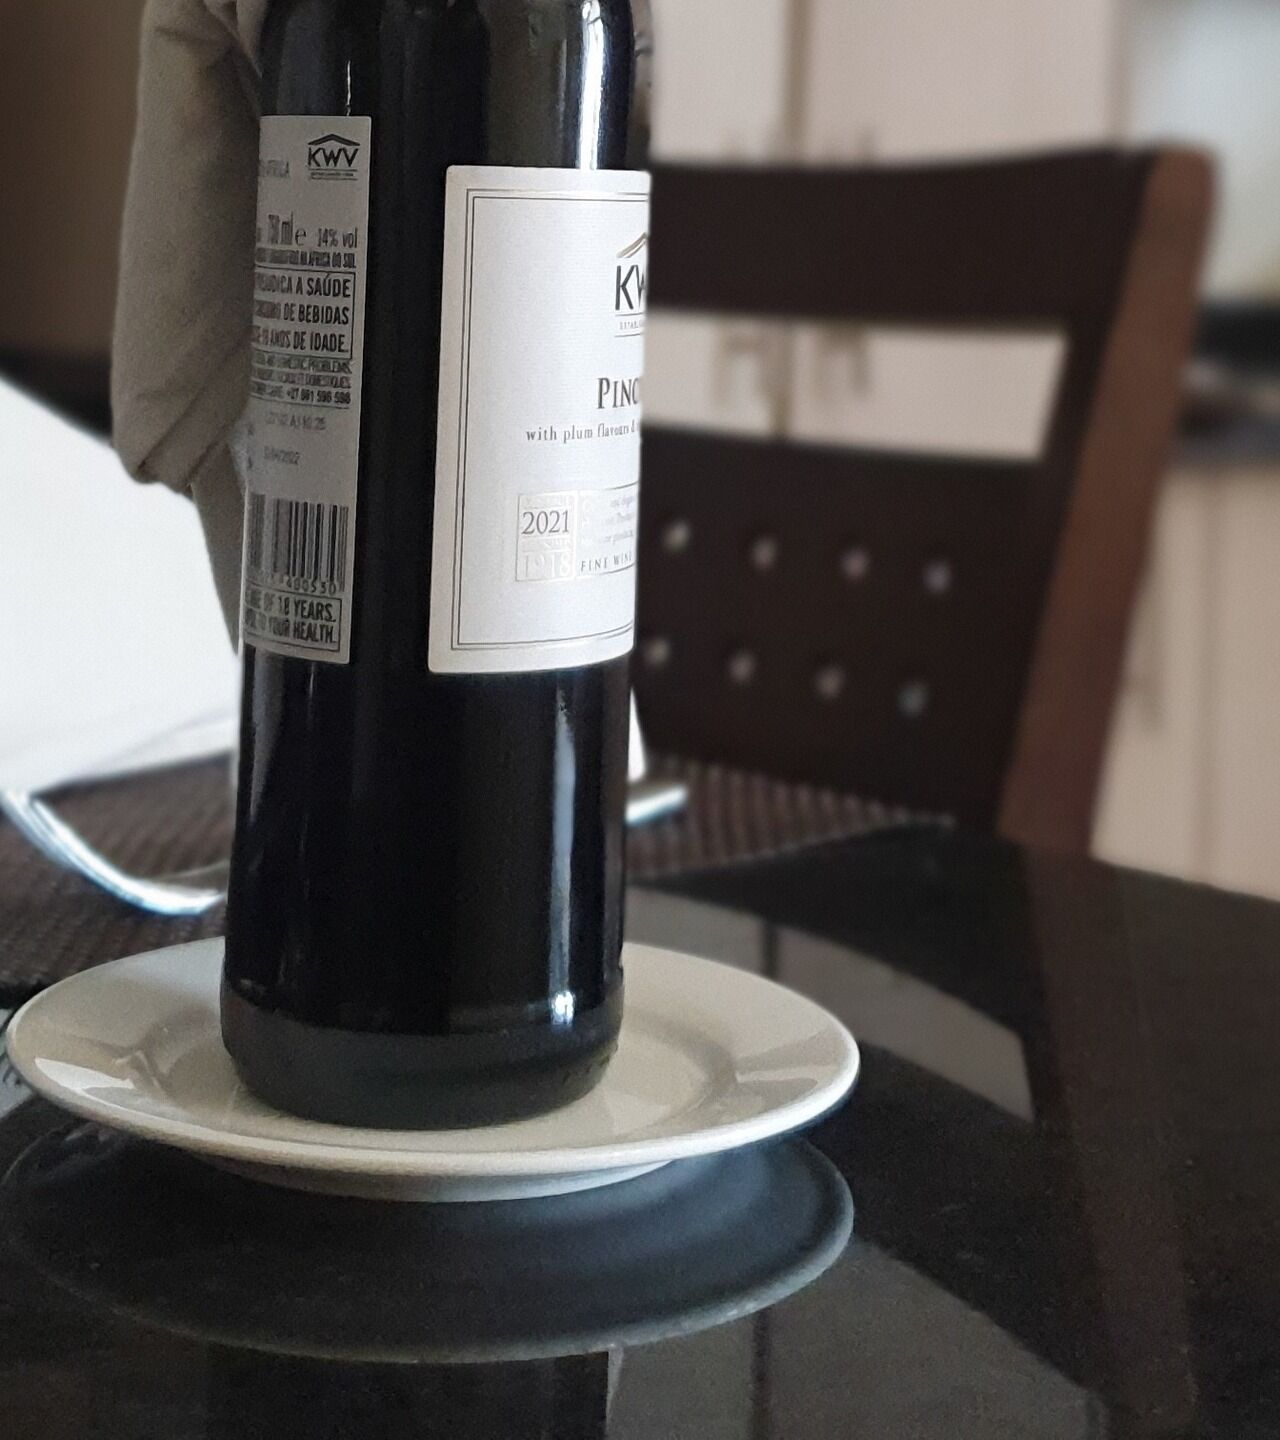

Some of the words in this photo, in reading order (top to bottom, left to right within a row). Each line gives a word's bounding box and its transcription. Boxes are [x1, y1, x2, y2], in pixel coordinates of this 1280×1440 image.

[307, 147, 359, 167] KWV
[342, 227, 358, 249] vol
[296, 276, 303, 295] A
[307, 273, 351, 297] SAÚDE
[283, 302, 296, 321] DE
[298, 304, 350, 325] BEBIDAS
[293, 331, 307, 350] DE
[310, 332, 348, 353] IDADE.
[526, 425, 557, 441] with
[564, 424, 593, 444] plum
[521, 510, 569, 535] 2021
[293, 599, 336, 623] YEARS.
[293, 619, 337, 644] HEALTH.
